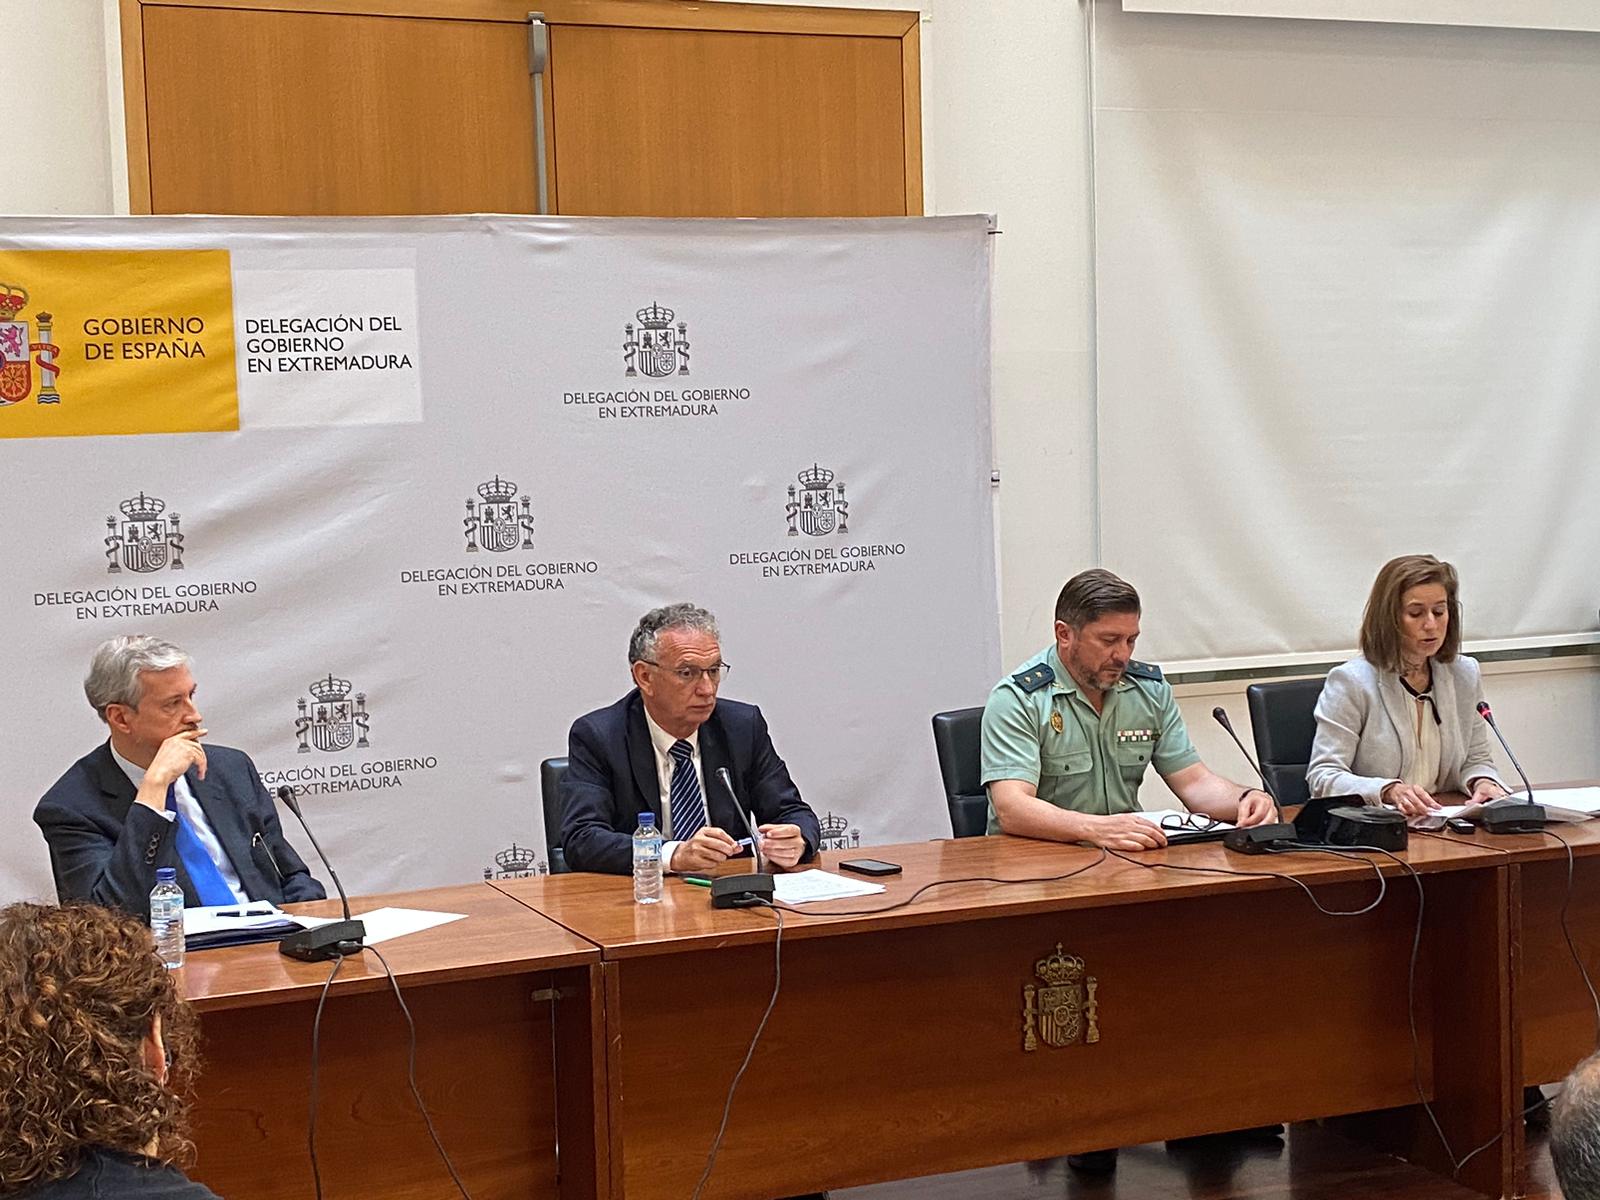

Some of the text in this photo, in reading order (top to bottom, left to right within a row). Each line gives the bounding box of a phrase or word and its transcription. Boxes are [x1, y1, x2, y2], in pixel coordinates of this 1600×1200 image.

[84, 317, 204, 335] GOBIERNO
[246, 314, 402, 334] DELEGACIÓN DEL
[85, 337, 205, 360] DE ESPAÑA
[247, 337, 344, 353] GOBIERNO
[248, 354, 412, 373] EN EXTREMADURA
[564, 388, 750, 404] DELEGACIÓN DEL GOBIERNO
[599, 404, 718, 418] EN EXTREMADURA
[730, 544, 905, 565] DELEGACIÓN DEL GOBIERNO
[401, 562, 598, 583] DELEGACIÓN DEL GOBIERNO
[763, 560, 875, 577] EN EXTREMADURA
[34, 581, 257, 606] DELEGACIÓN DEL GOBIERNO
[439, 578, 564, 596] EN EXTREMADURA
[77, 599, 219, 619] EN EXTREMADURA
[330, 764, 357, 777] DEL
[361, 757, 437, 774] GOBIERNO
[294, 774, 402, 796] EXTREMADURA
